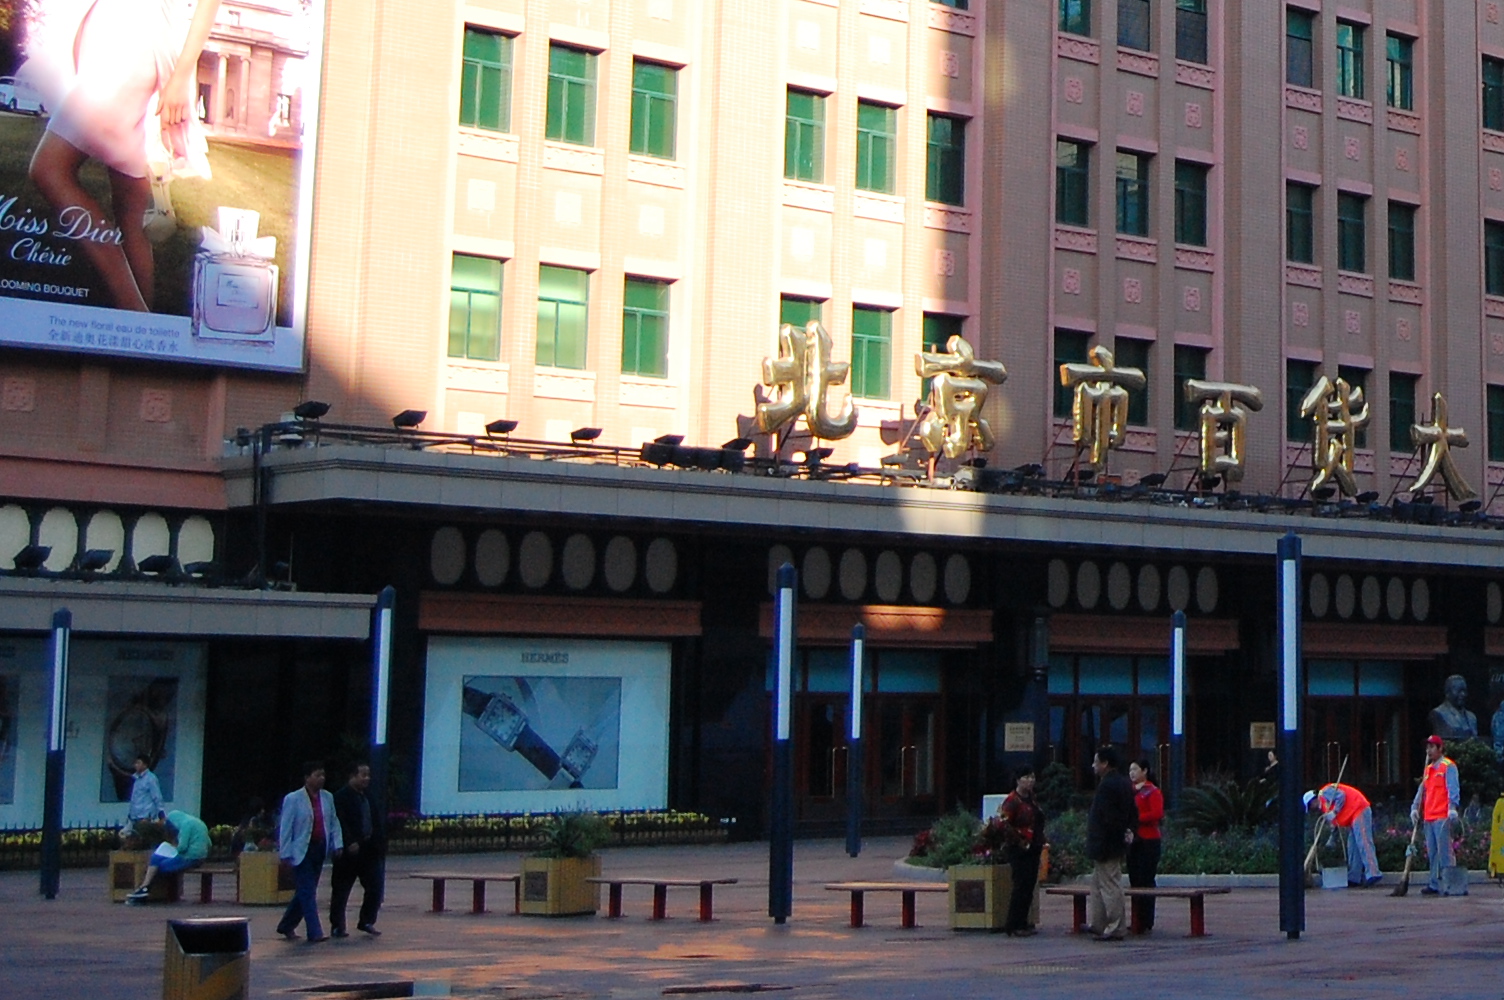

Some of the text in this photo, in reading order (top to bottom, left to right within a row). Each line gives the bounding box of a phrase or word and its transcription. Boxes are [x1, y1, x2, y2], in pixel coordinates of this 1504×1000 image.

[52, 206, 124, 245] Dior
[11, 237, 73, 266] Chérie
[0, 278, 90, 298] OOMING BOUQUET
[49, 315, 67, 326] The
[69, 319, 88, 329] new
[116, 324, 133, 333] eau
[135, 325, 148, 335] de
